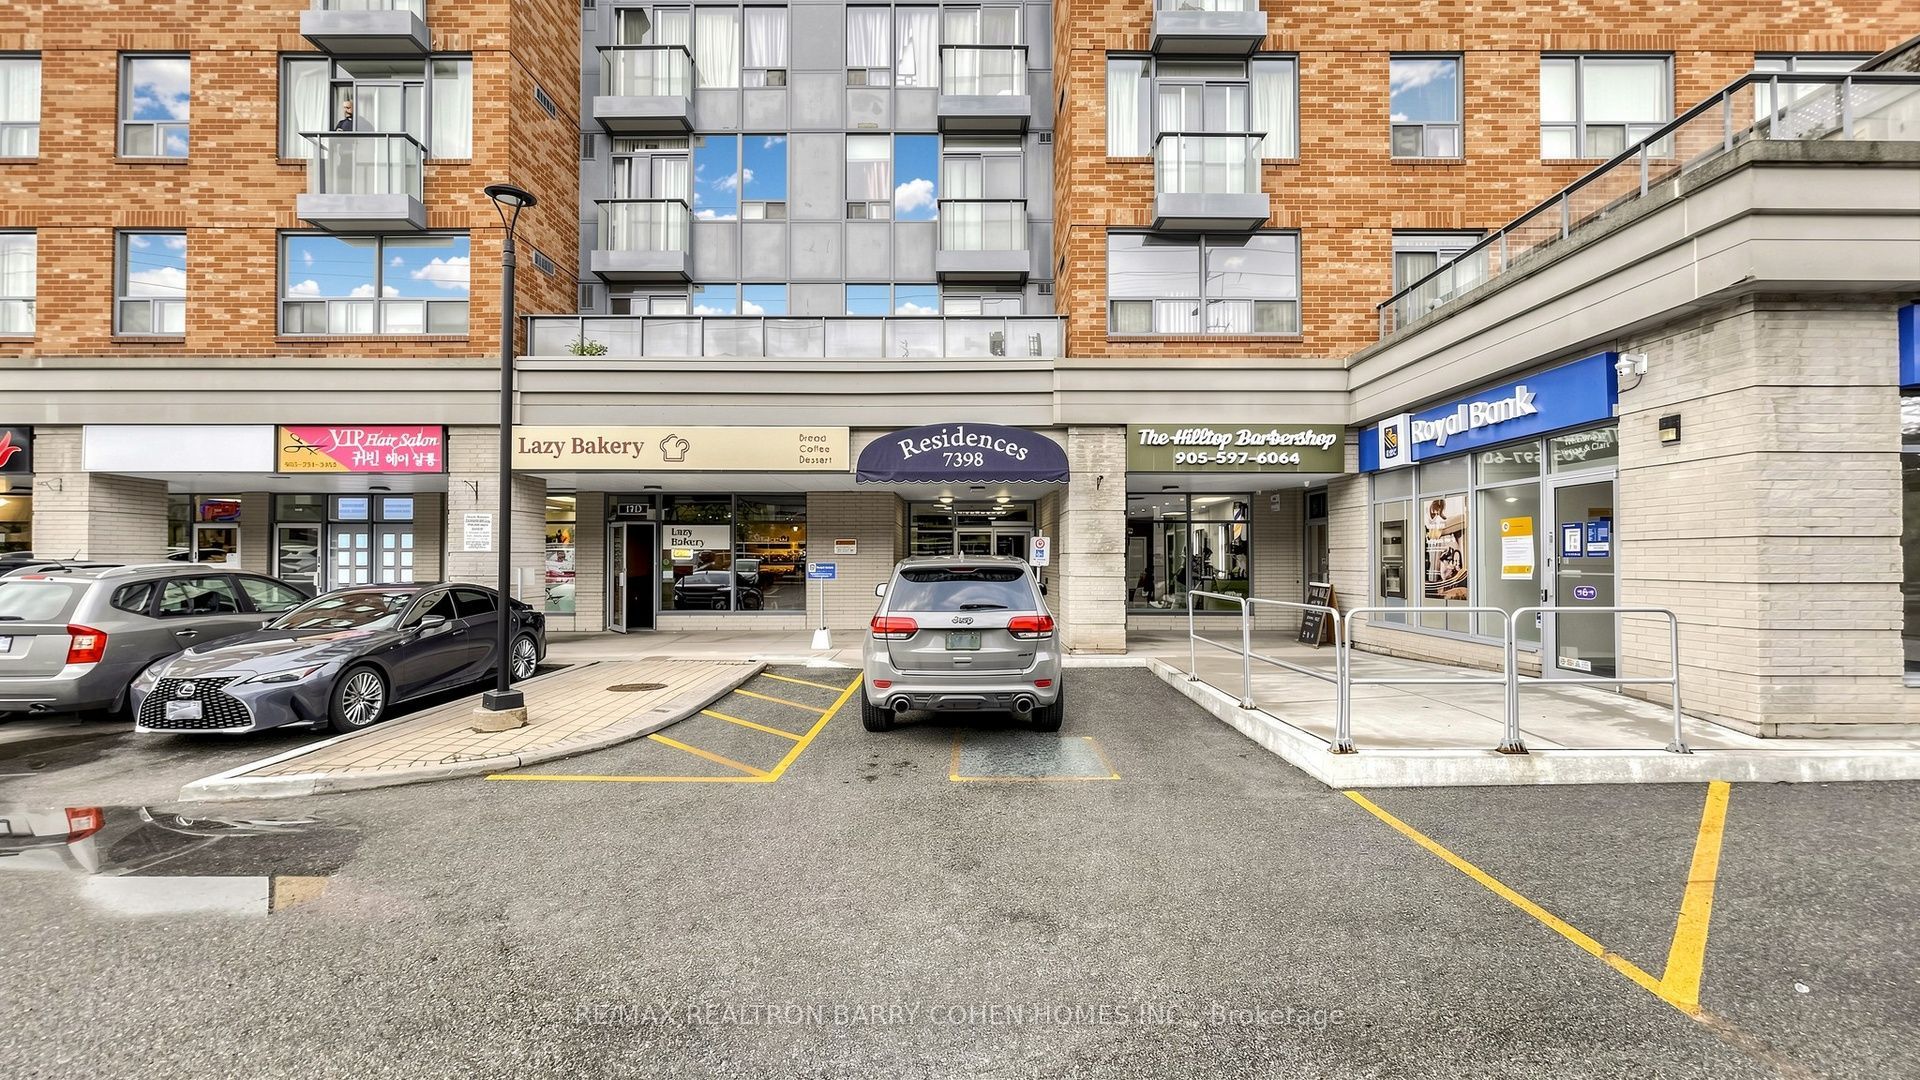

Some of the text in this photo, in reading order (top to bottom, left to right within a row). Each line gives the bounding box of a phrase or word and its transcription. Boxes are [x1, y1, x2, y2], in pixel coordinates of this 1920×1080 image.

[1411, 385, 1538, 446] Royal Bank
[329, 428, 439, 451] VIP Hair Salon
[799, 433, 827, 442] Bread
[897, 426, 1028, 460] Residences
[1138, 428, 1336, 450] The Hilltop Barbershop
[518, 436, 645, 458] Lazy Bakery
[799, 444, 830, 453] Coffee
[799, 455, 832, 464] Dessert
[942, 452, 984, 467] 7398
[1175, 452, 1300, 464] 905-597-6064
[671, 528, 693, 537] Lazy
[671, 538, 704, 547] Bakery
[952, 616, 974, 625] Jeep
